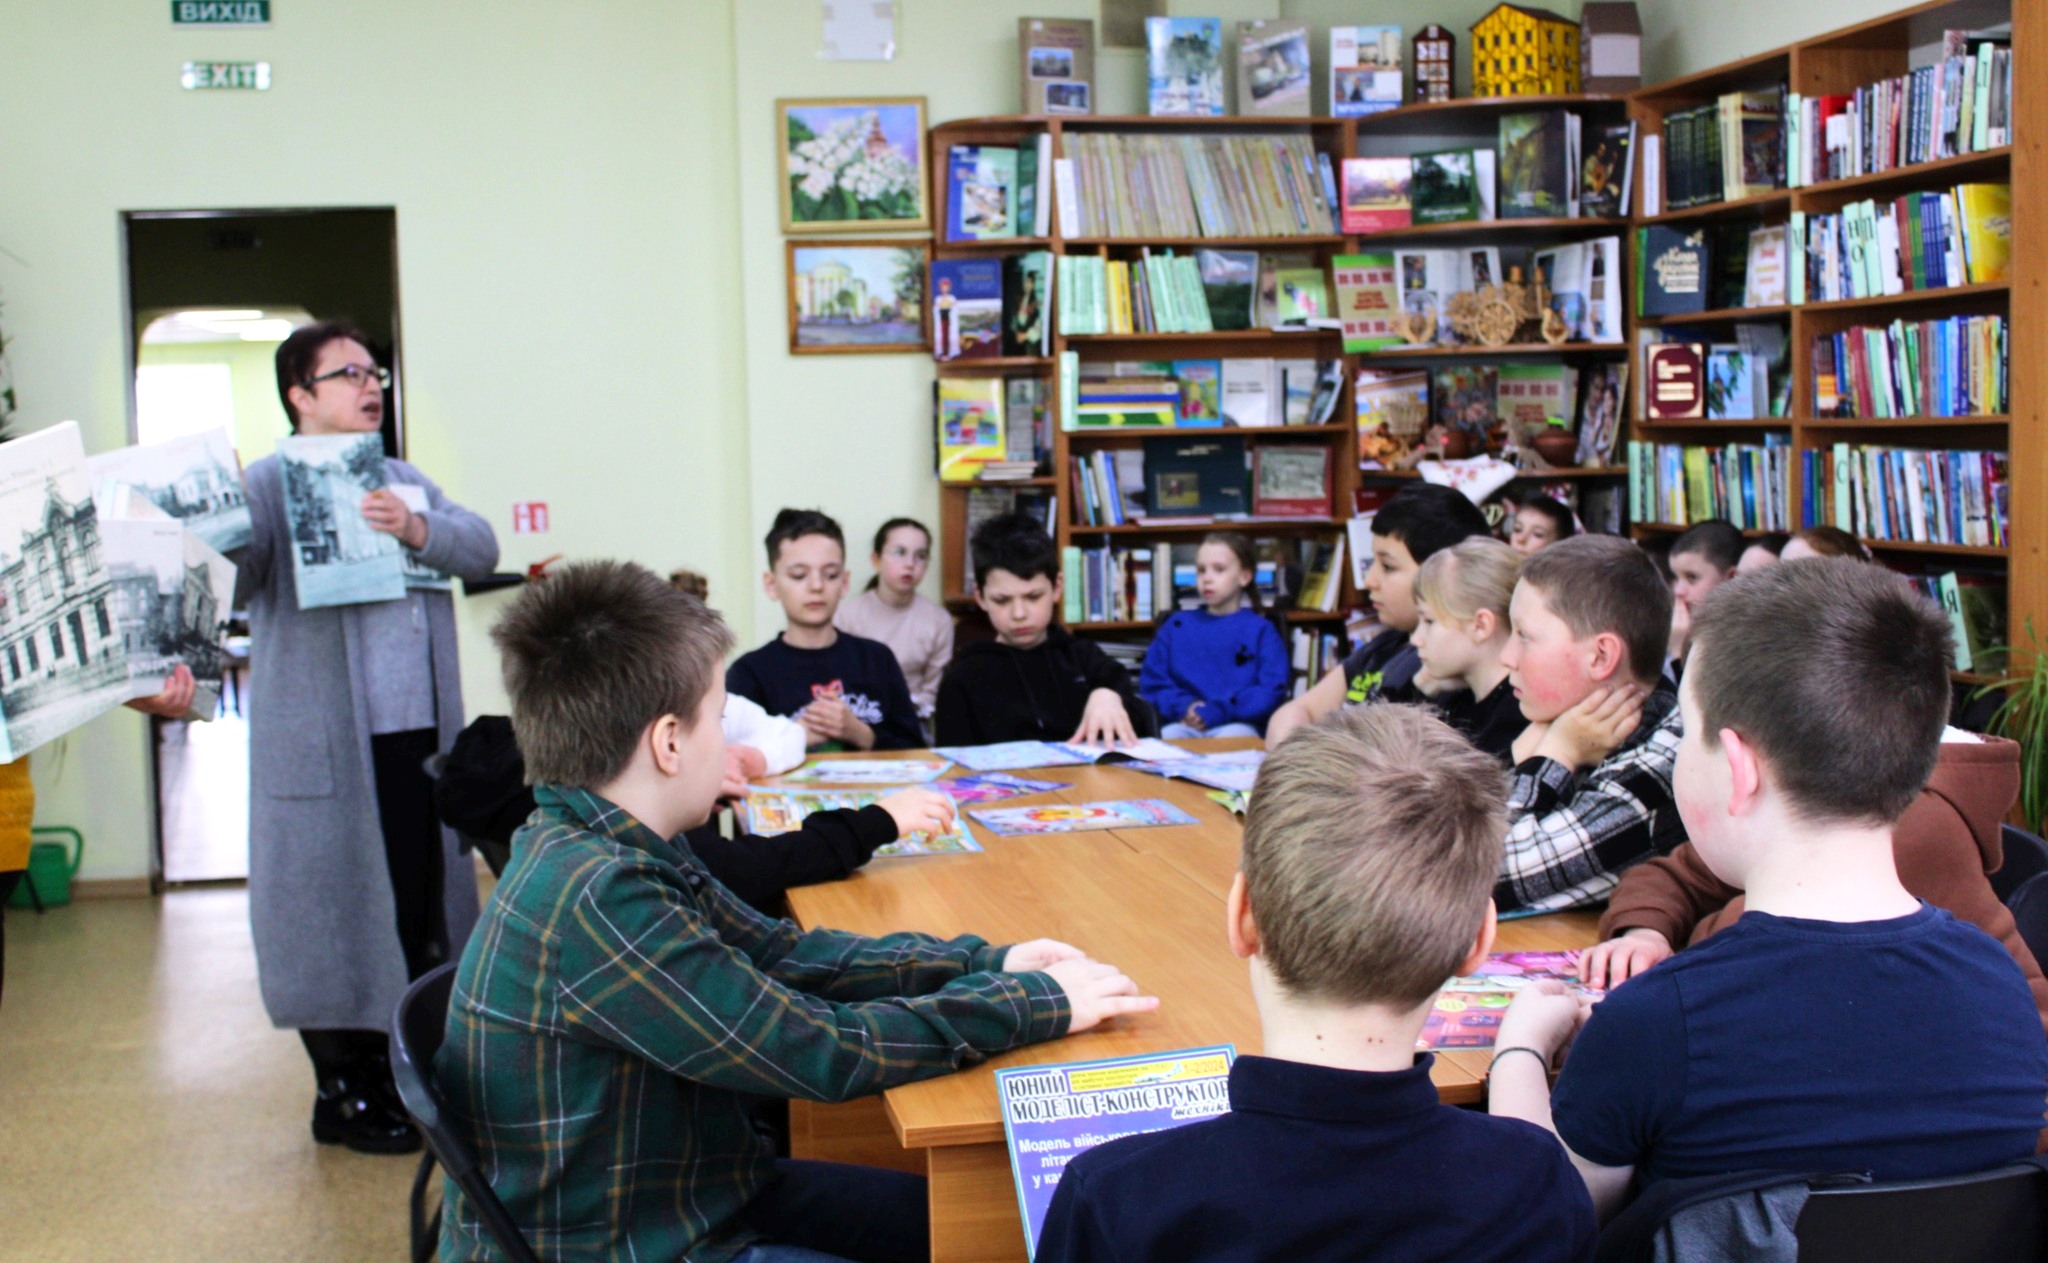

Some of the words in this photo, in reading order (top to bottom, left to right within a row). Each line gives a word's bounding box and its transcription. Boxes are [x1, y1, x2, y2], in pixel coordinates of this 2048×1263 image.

[180, 2, 262, 22] ВИХІД
[194, 64, 256, 88] EXIT
[1945, 589, 1959, 614] Я
[1007, 1071, 1066, 1099] ЮНИЙ
[1018, 1138, 1071, 1154] Модель
[1032, 1174, 1041, 1190] у
